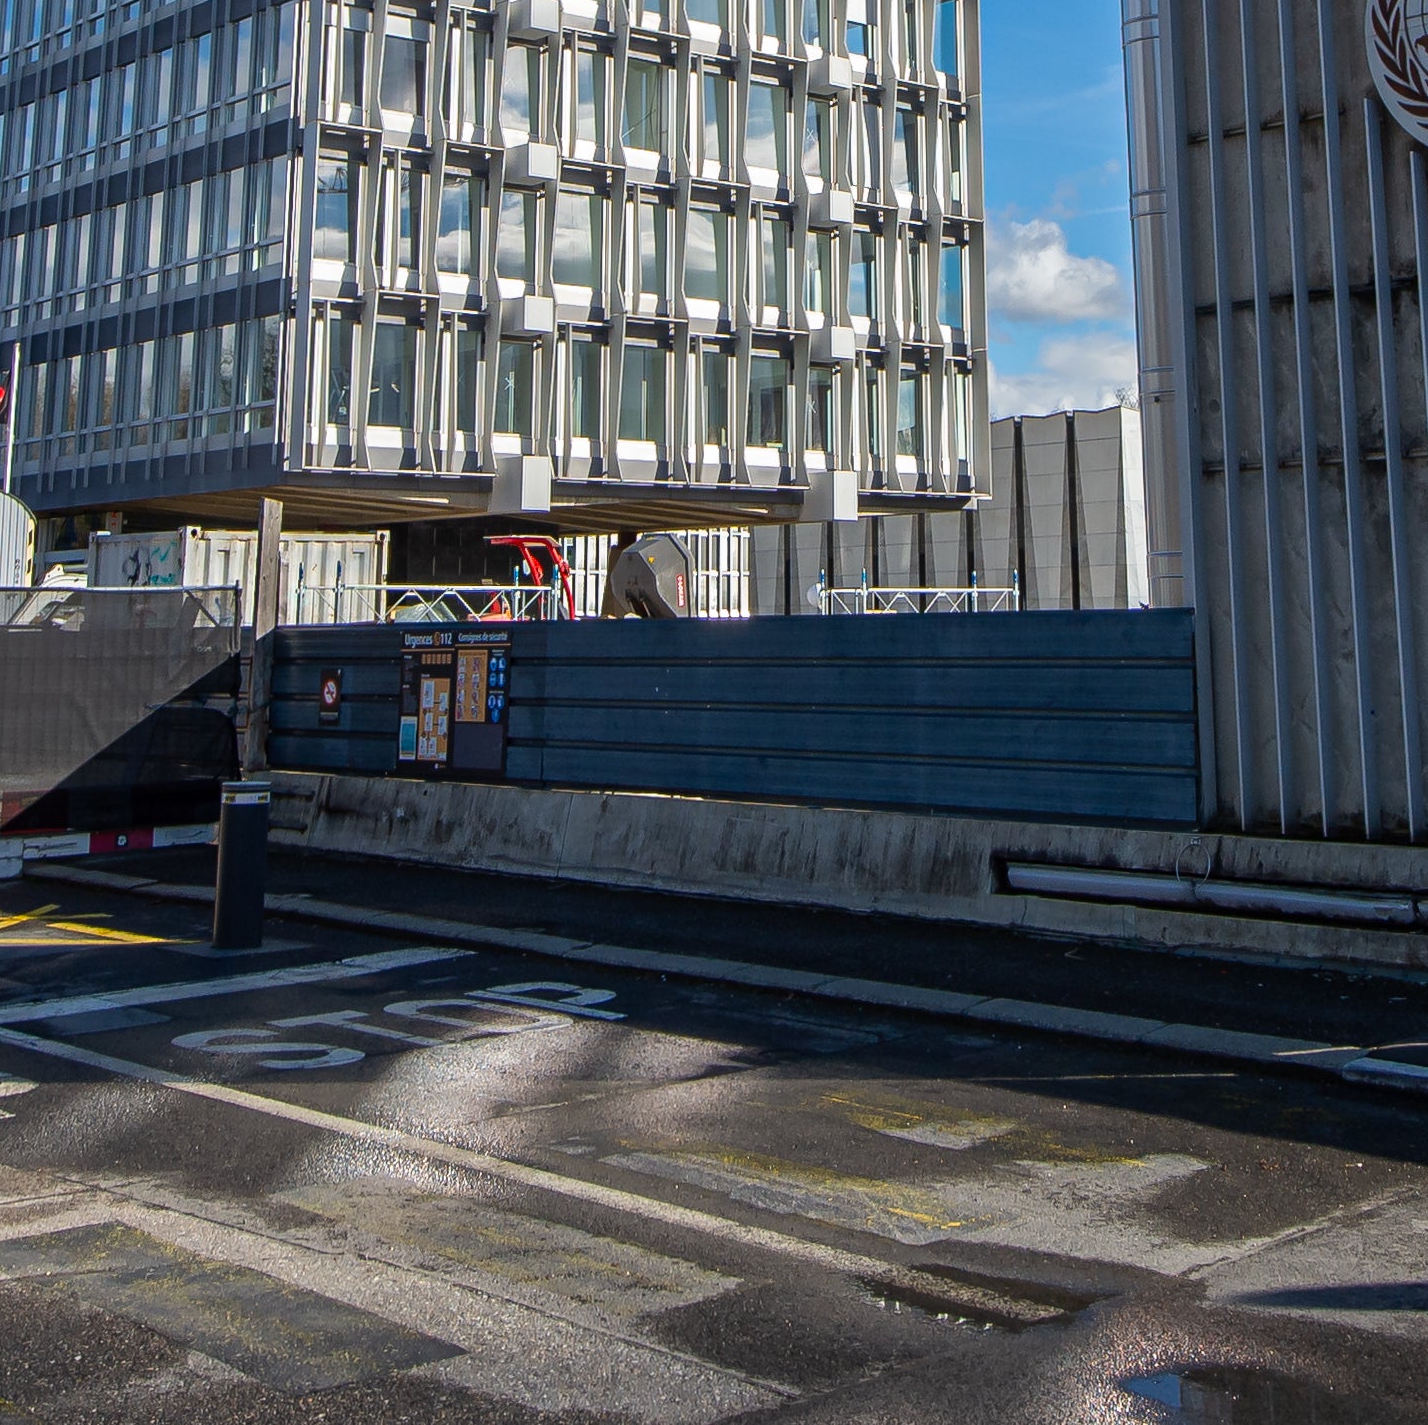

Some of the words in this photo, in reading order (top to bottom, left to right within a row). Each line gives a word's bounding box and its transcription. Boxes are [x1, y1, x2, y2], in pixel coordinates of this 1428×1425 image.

[404, 634, 433, 649] Urgences
[440, 633, 453, 645] 112
[171, 981, 628, 1070] STOP
